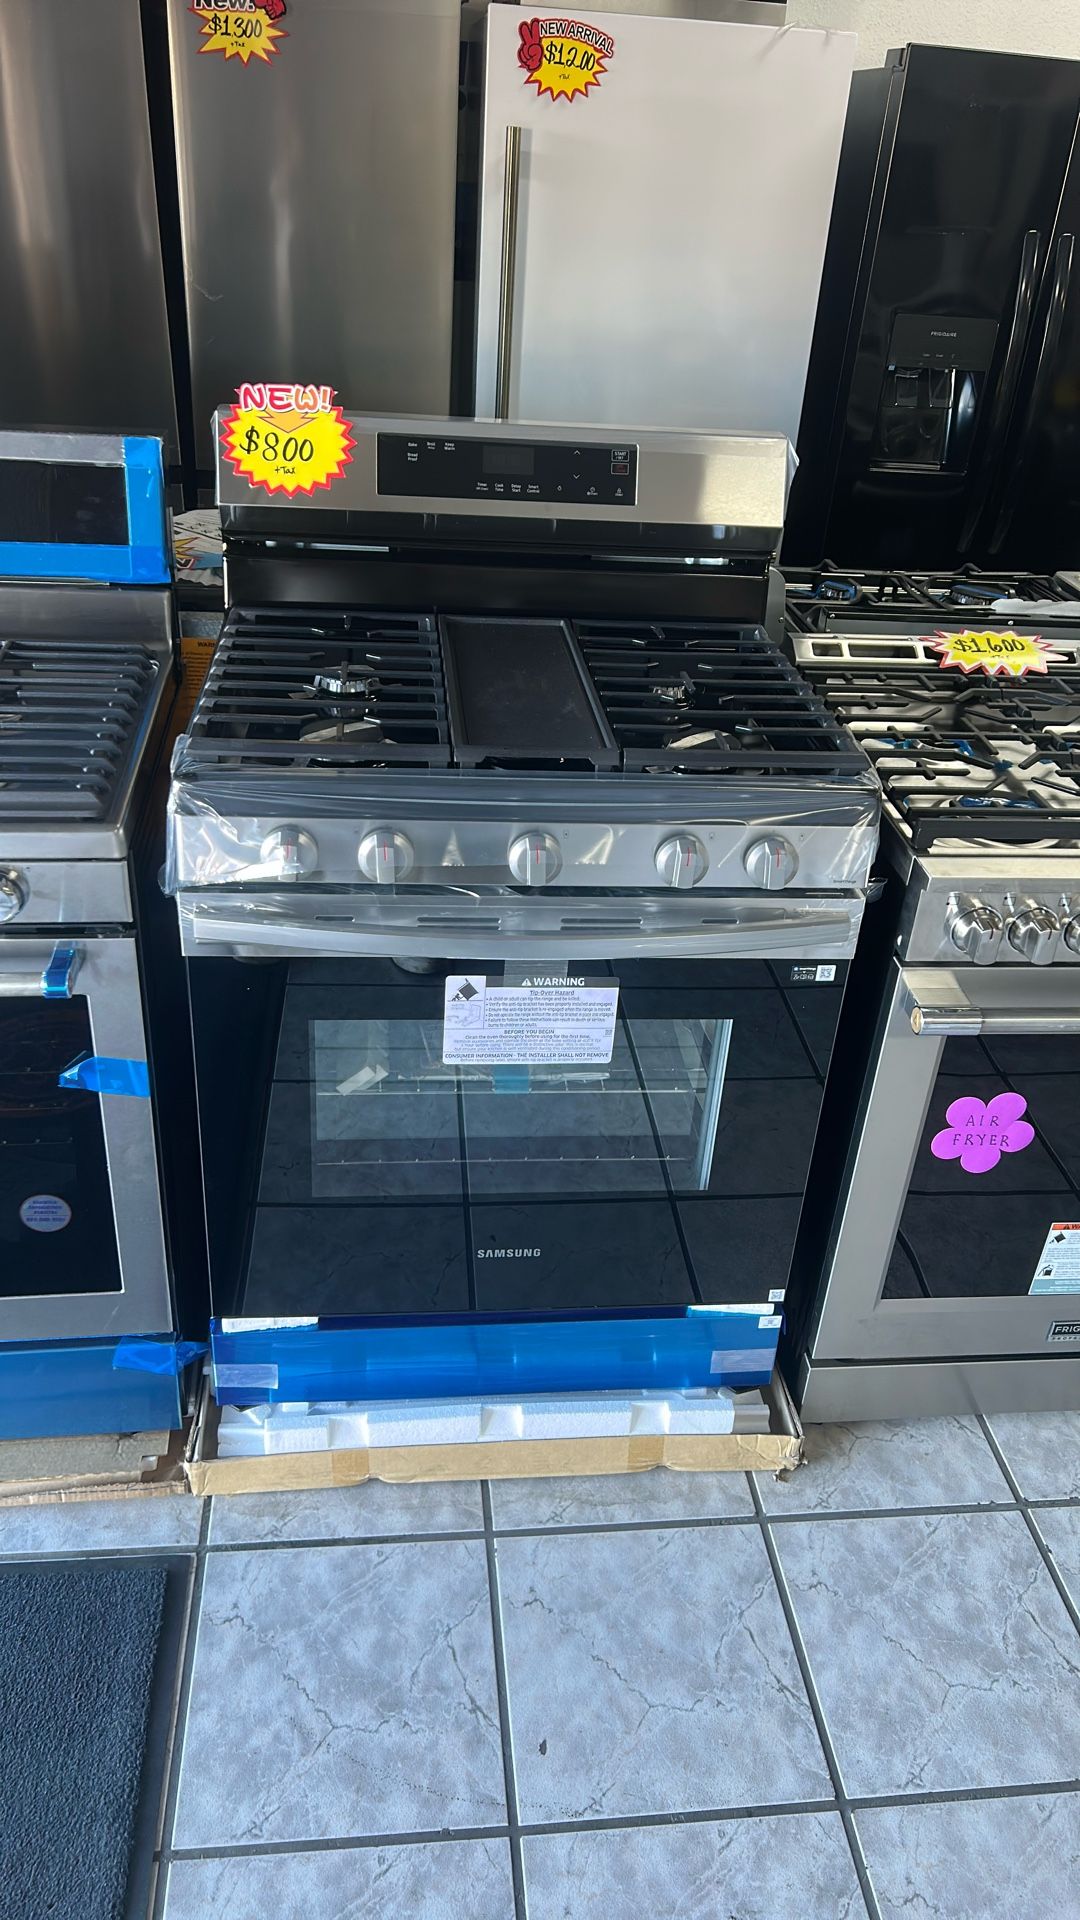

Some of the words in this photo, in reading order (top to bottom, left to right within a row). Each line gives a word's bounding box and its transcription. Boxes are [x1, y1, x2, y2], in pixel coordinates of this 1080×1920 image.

[540, 21, 567, 35] NEW
[568, 24, 613, 55] ARRIVAL
[240, 383, 334, 414] NEW!
[238, 425, 315, 462] $800
[533, 977, 585, 986] WARNING
[965, 1114, 999, 1127] AIR
[953, 1133, 1009, 1147] FRYER
[477, 1248, 541, 1259] SAMSUNG
